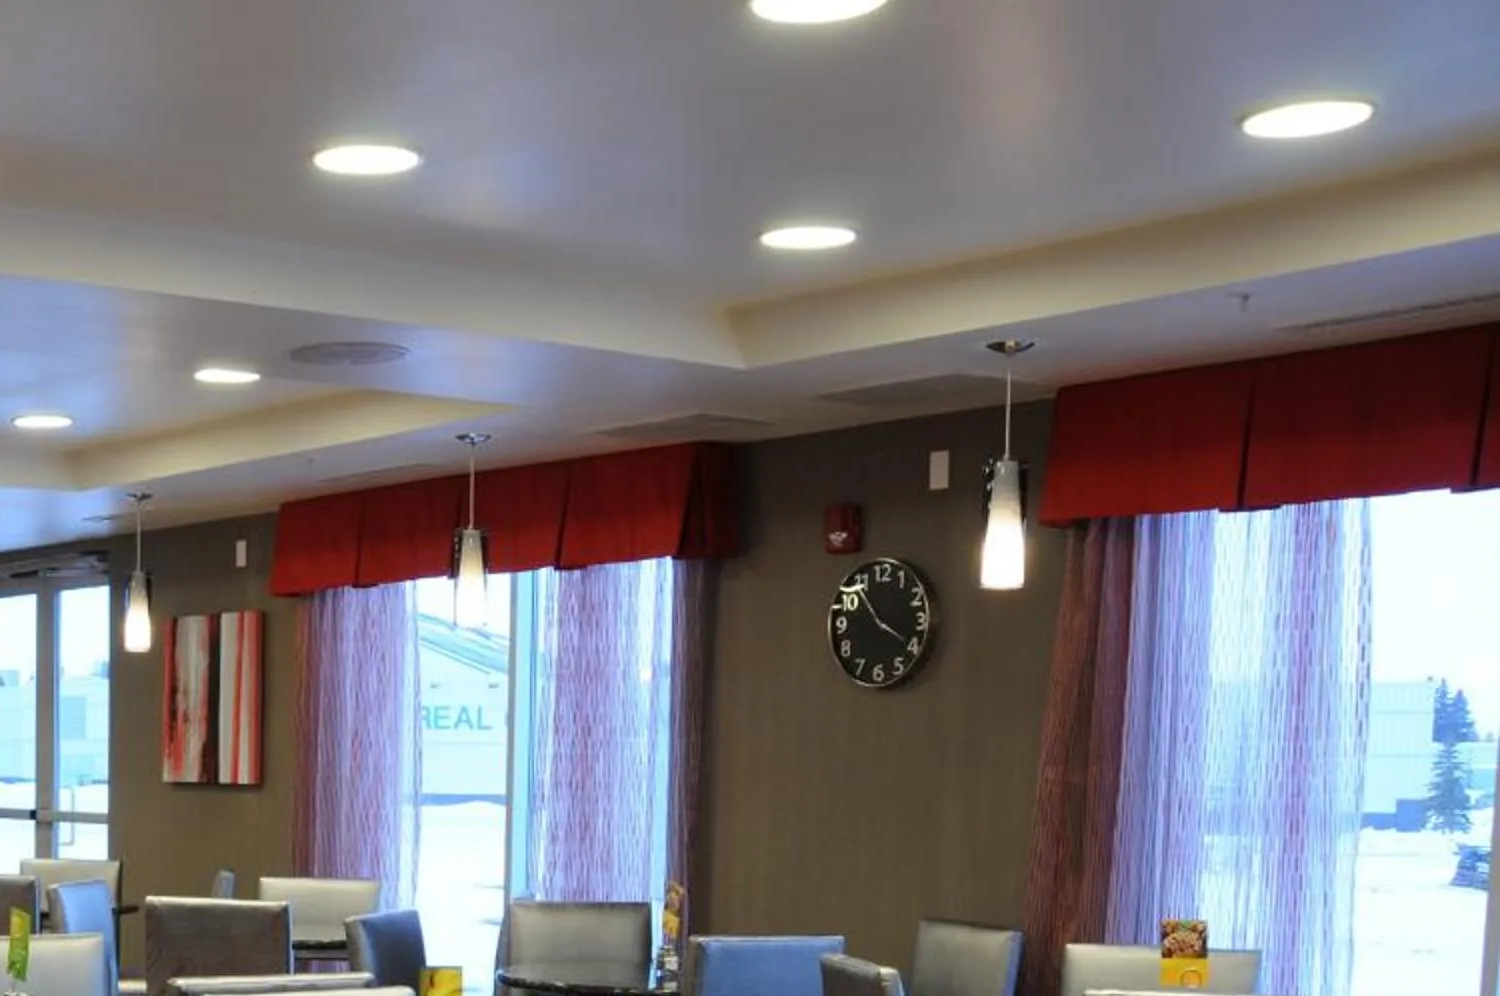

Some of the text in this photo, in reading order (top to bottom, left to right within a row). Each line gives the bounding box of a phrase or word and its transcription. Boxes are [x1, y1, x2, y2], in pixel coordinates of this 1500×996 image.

[854, 574, 869, 591] 11
[873, 564, 892, 583] 12
[897, 570, 905, 589] 1
[841, 594, 859, 611] 10
[910, 587, 924, 607] 2
[836, 616, 847, 634] 9
[915, 612, 927, 631] 3
[841, 640, 851, 657] 8
[907, 637, 919, 655] 4
[854, 658, 866, 676] 7
[873, 664, 885, 682] 6
[892, 657, 905, 675] 5
